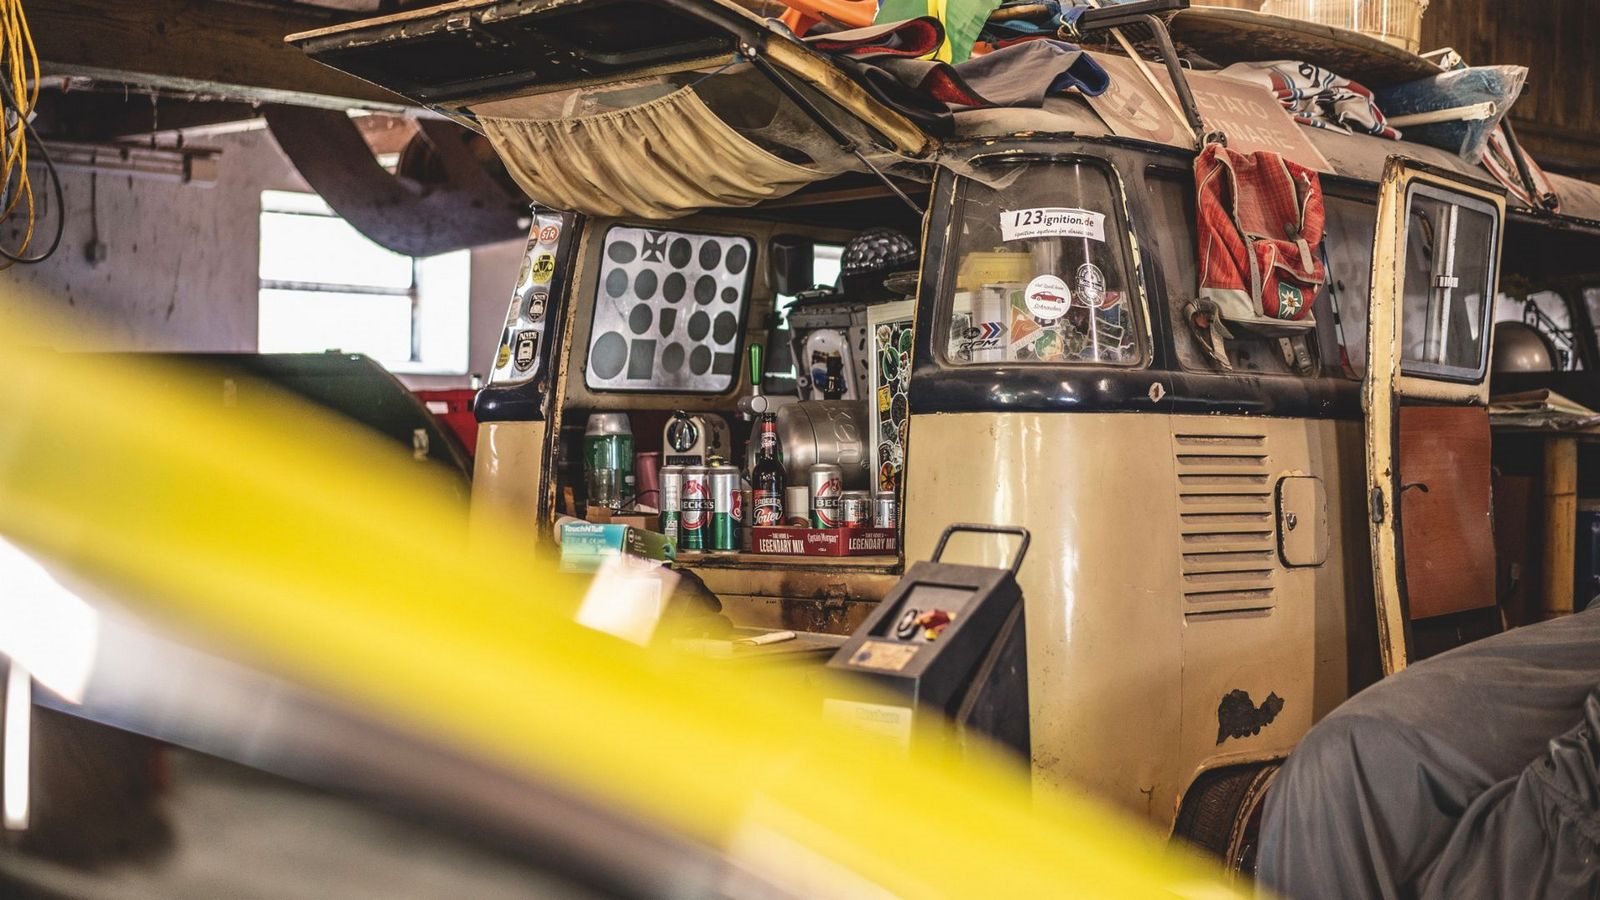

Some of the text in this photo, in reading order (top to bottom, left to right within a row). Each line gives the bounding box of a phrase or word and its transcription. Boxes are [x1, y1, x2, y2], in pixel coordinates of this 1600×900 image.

[1196, 91, 1269, 120] ETATO
[1204, 116, 1296, 150] UMARE
[1015, 210, 1094, 227] 123ignition.de
[959, 339, 999, 349] RPM
[760, 538, 805, 553] LEGENDARY MIX
[849, 537, 885, 550] LEGENDARY
